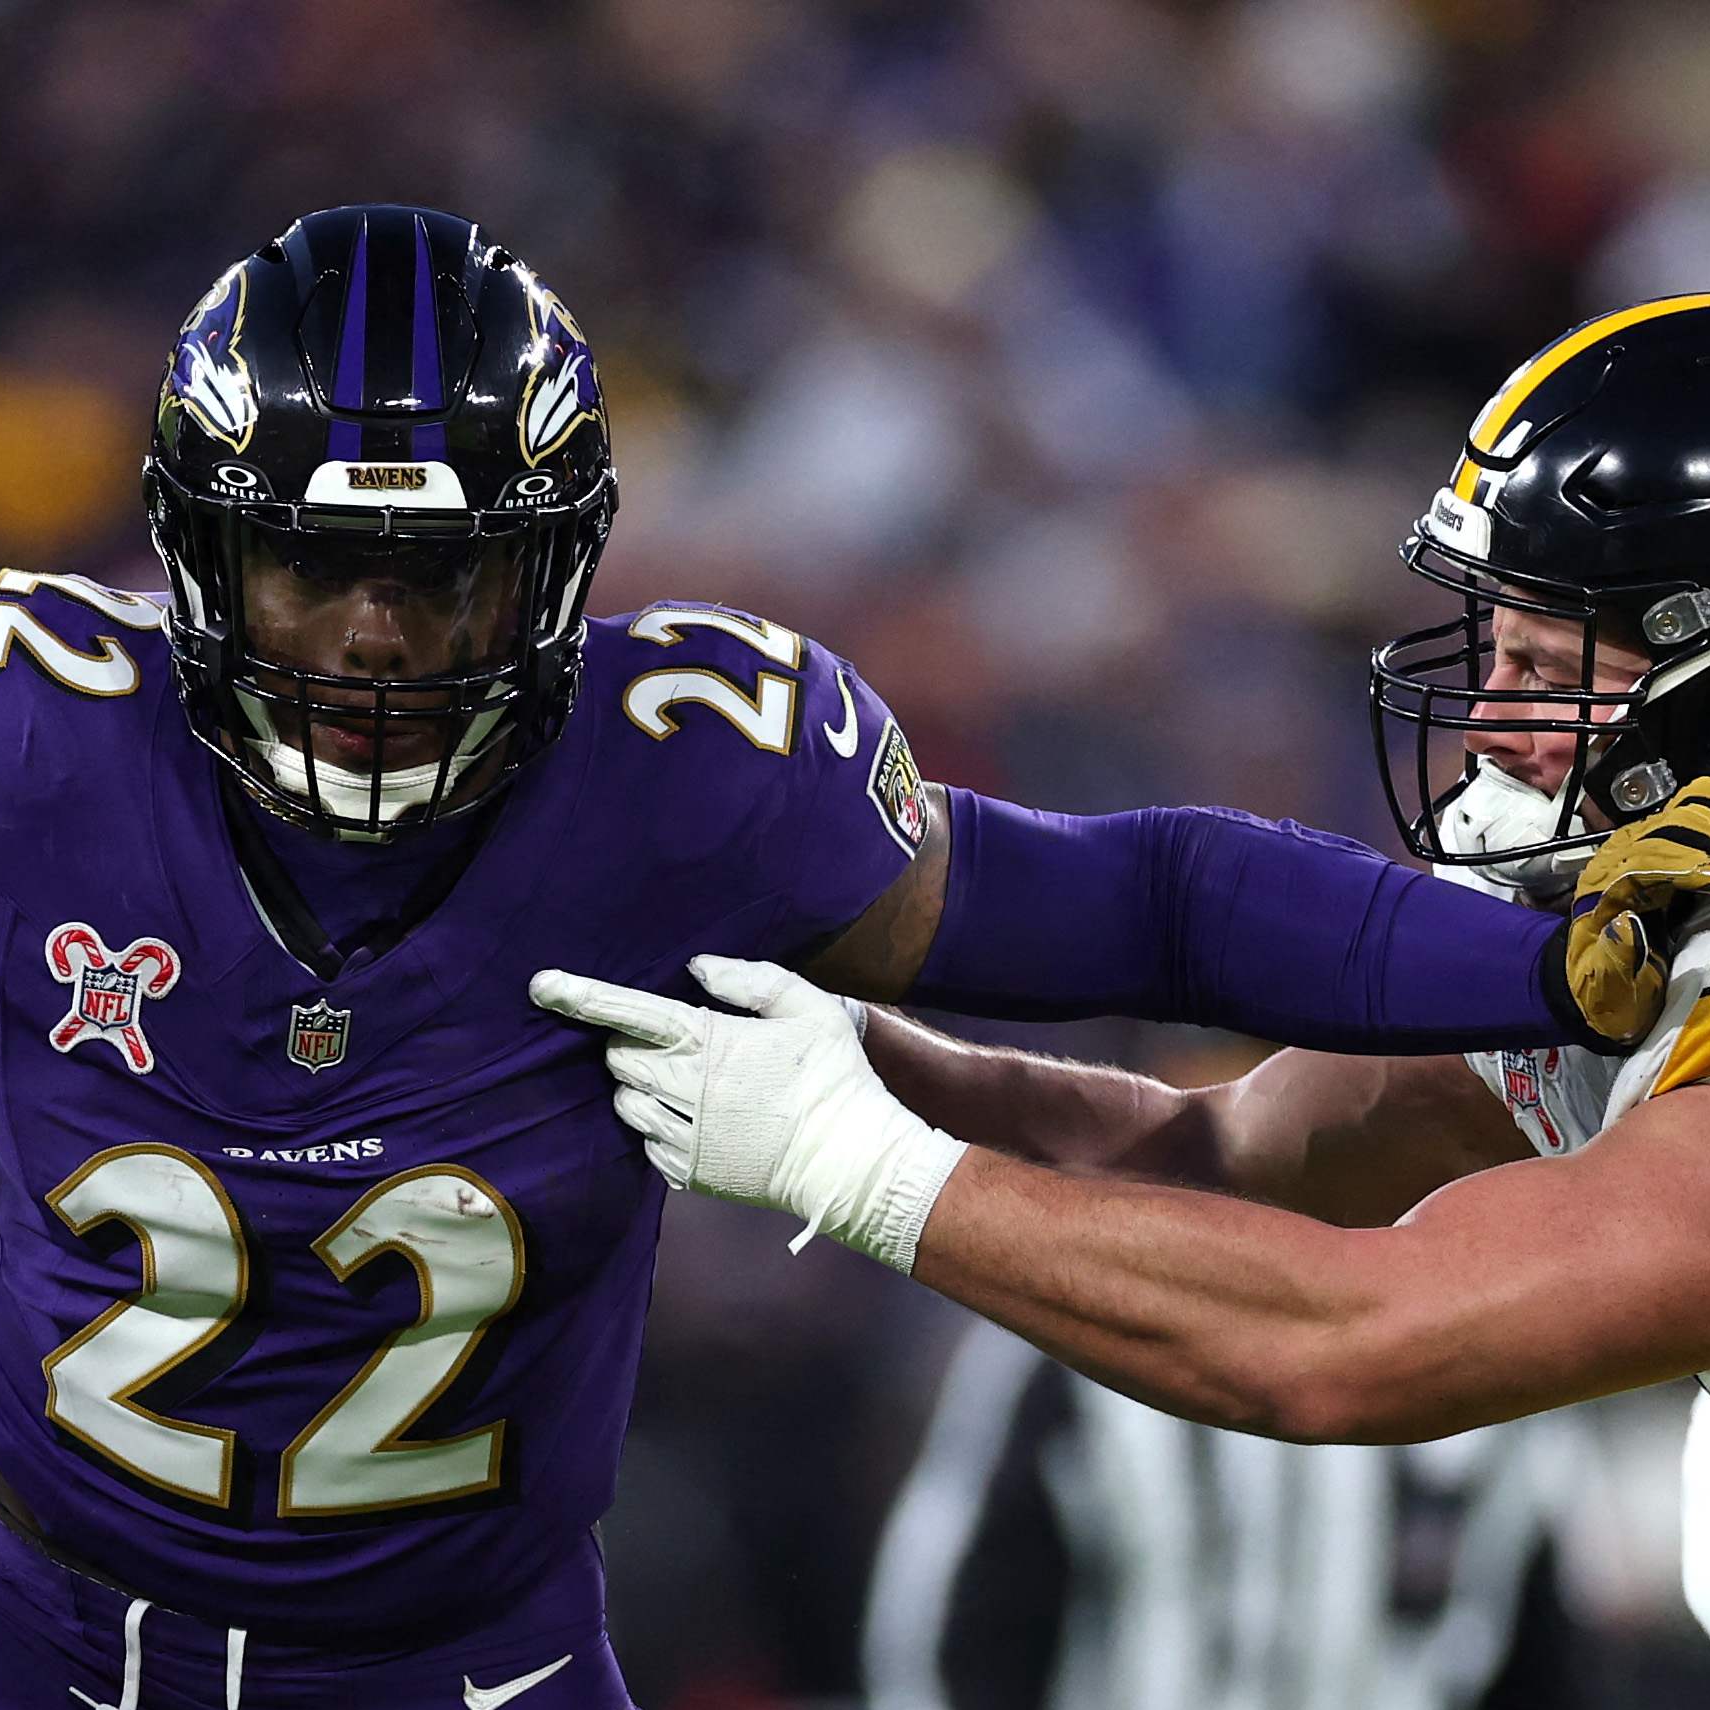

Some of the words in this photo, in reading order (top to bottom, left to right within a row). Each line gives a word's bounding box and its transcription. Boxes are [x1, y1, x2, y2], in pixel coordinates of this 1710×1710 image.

[210, 481, 271, 500] OAKLEY
[346, 466, 427, 491] RAVENS
[505, 492, 561, 509] OAKLEY
[622, 607, 801, 757] 22
[83, 991, 129, 1024] NFL
[296, 1033, 338, 1060] NFL
[1506, 1070, 1538, 1103] NFL
[42, 1142, 525, 1518] 22
